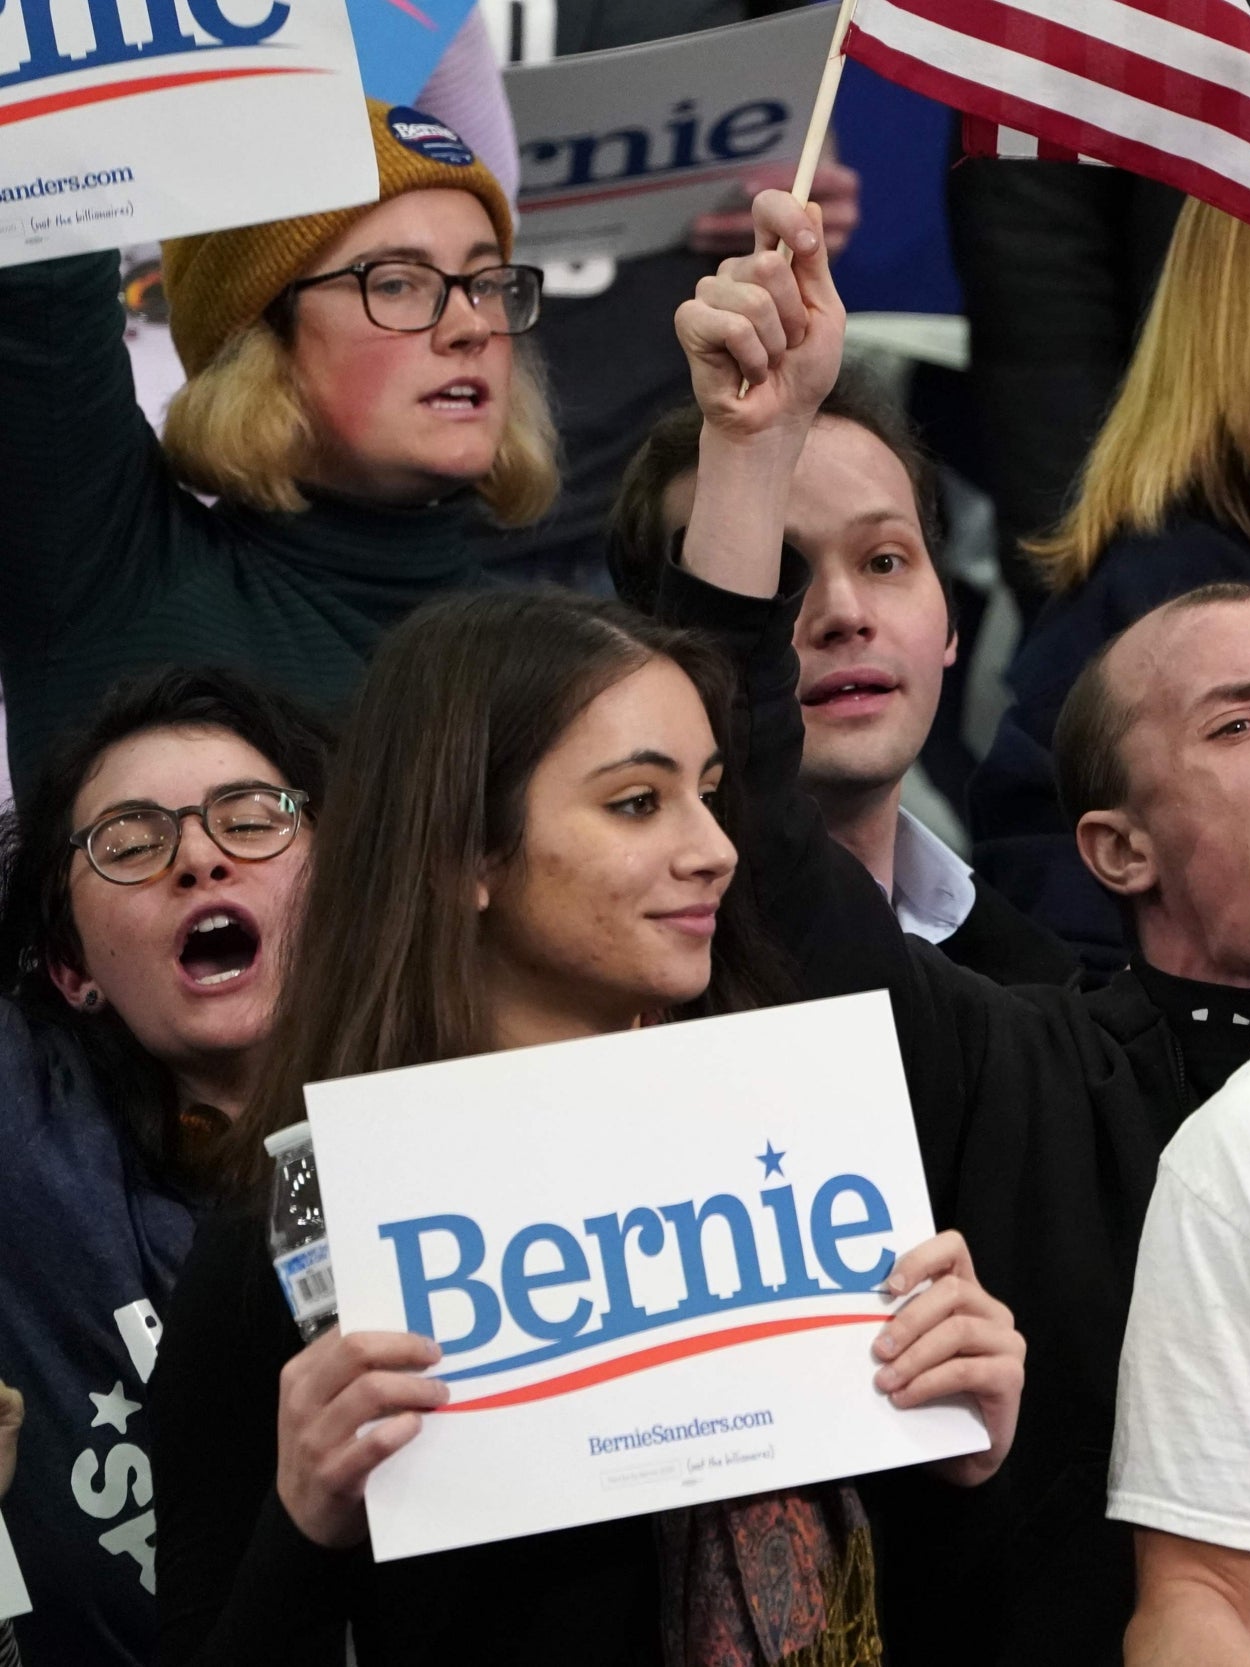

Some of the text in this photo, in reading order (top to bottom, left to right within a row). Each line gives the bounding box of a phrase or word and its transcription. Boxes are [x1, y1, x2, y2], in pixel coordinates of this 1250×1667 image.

[0, 166, 135, 203] anders.com
[55, 213, 72, 228] the
[377, 1138, 896, 1357] Bernie
[588, 1409, 774, 1456] BernieSanders.com
